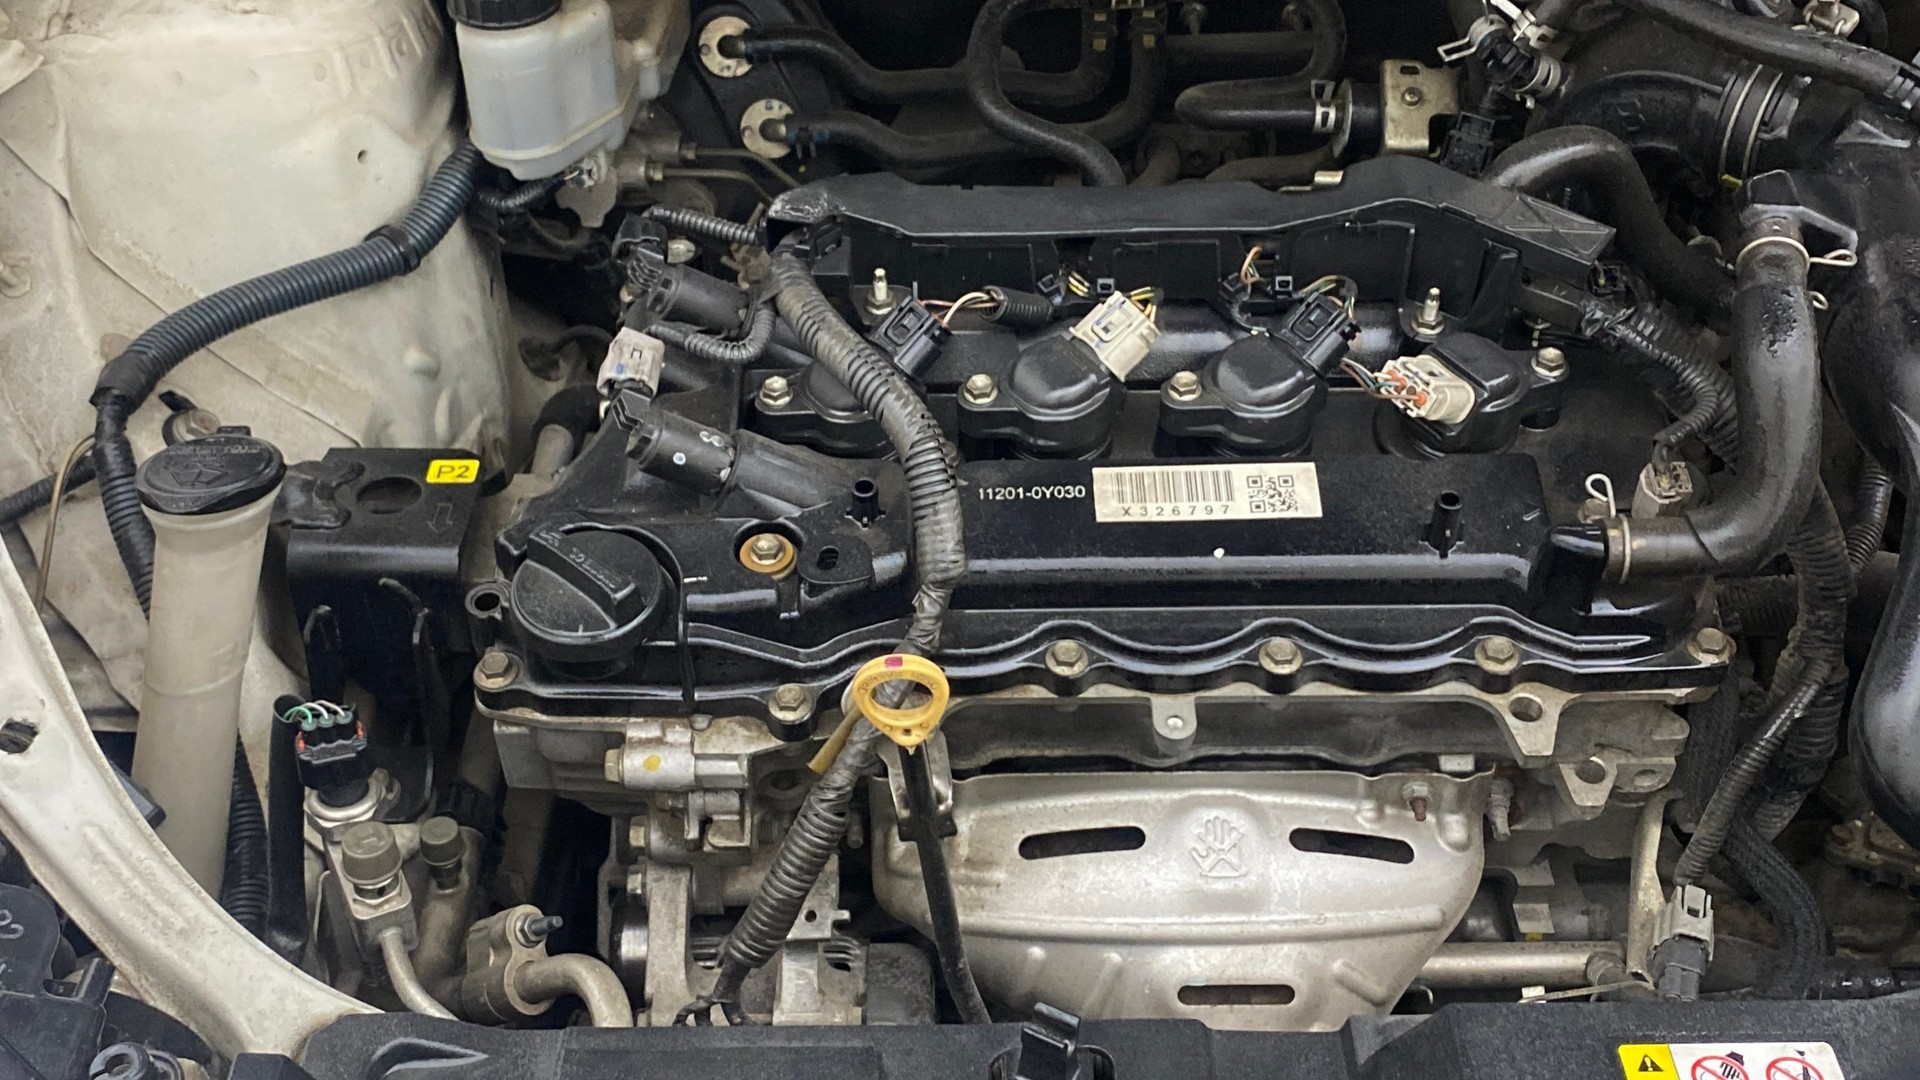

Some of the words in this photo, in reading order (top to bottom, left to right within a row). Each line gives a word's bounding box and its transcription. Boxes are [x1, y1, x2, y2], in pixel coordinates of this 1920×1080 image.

[436, 464, 470, 479] P2
[977, 484, 1086, 501] 11201-0Y030
[1120, 503, 1231, 518] X326797
